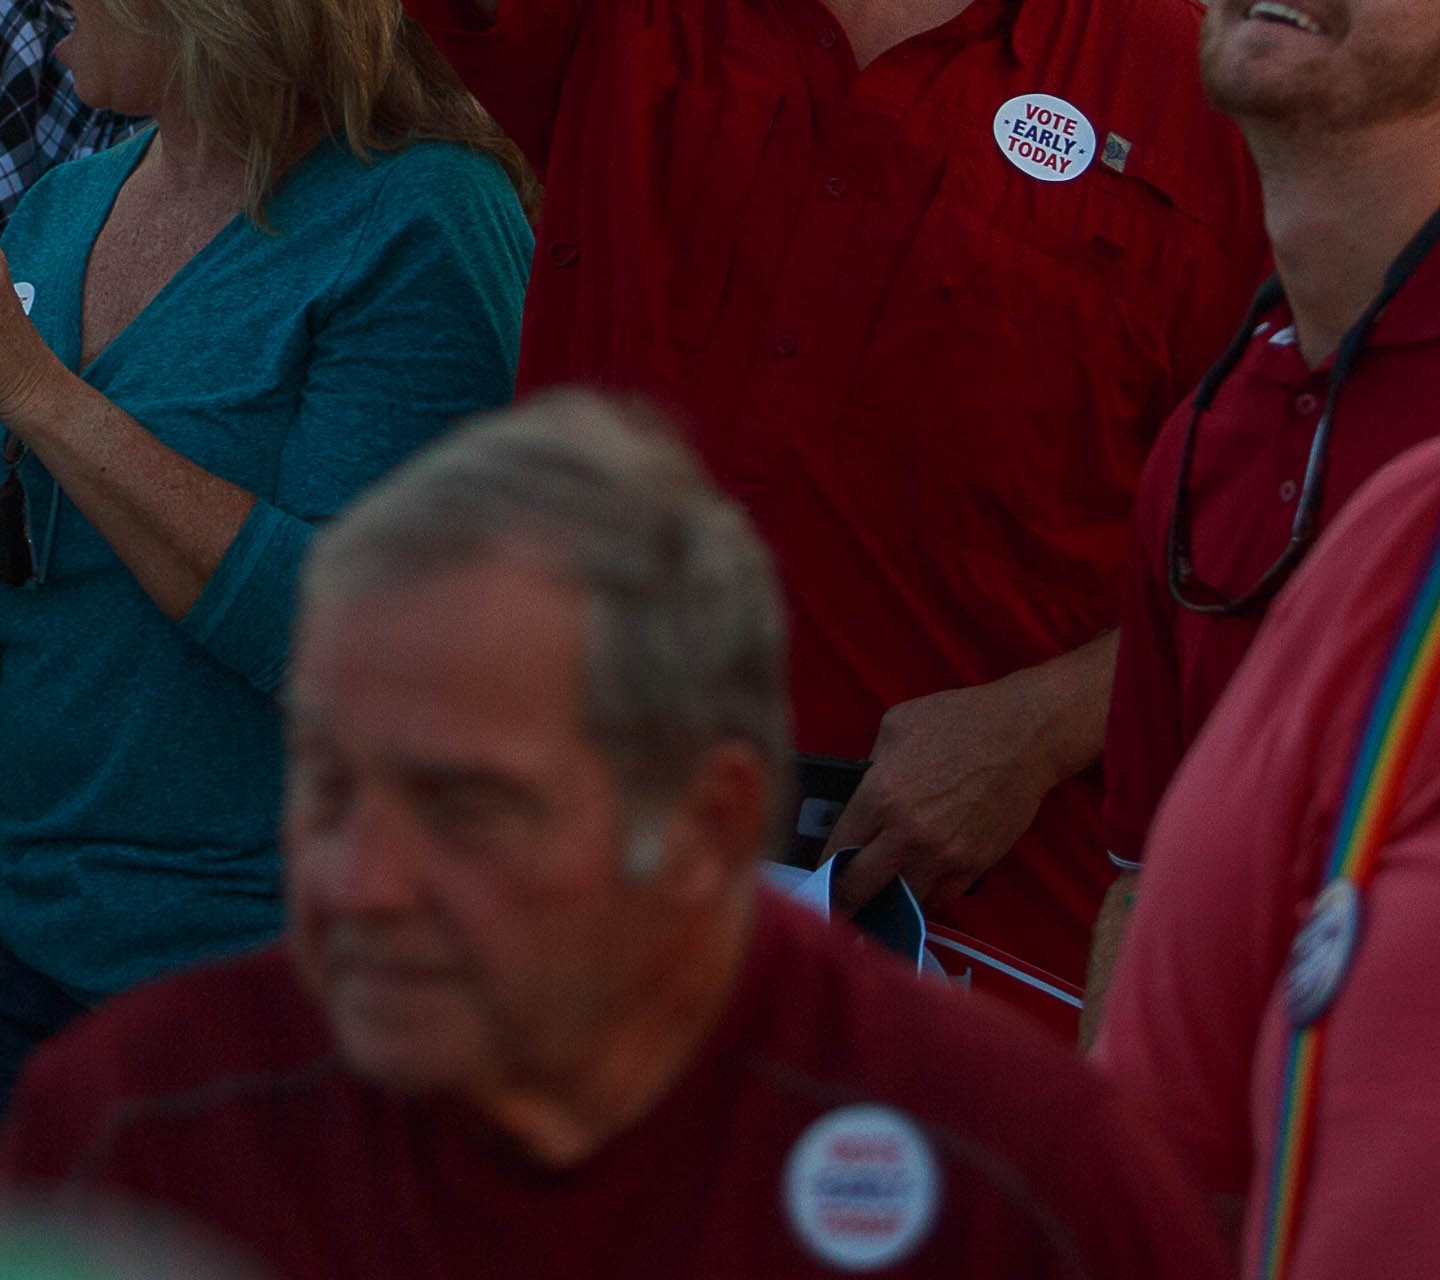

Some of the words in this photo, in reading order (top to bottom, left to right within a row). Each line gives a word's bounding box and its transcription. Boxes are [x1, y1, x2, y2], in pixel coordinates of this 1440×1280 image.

[1009, 118, 1078, 156] EARLY
[1024, 102, 1077, 137] VOTE
[1008, 135, 1073, 175] TODAY
